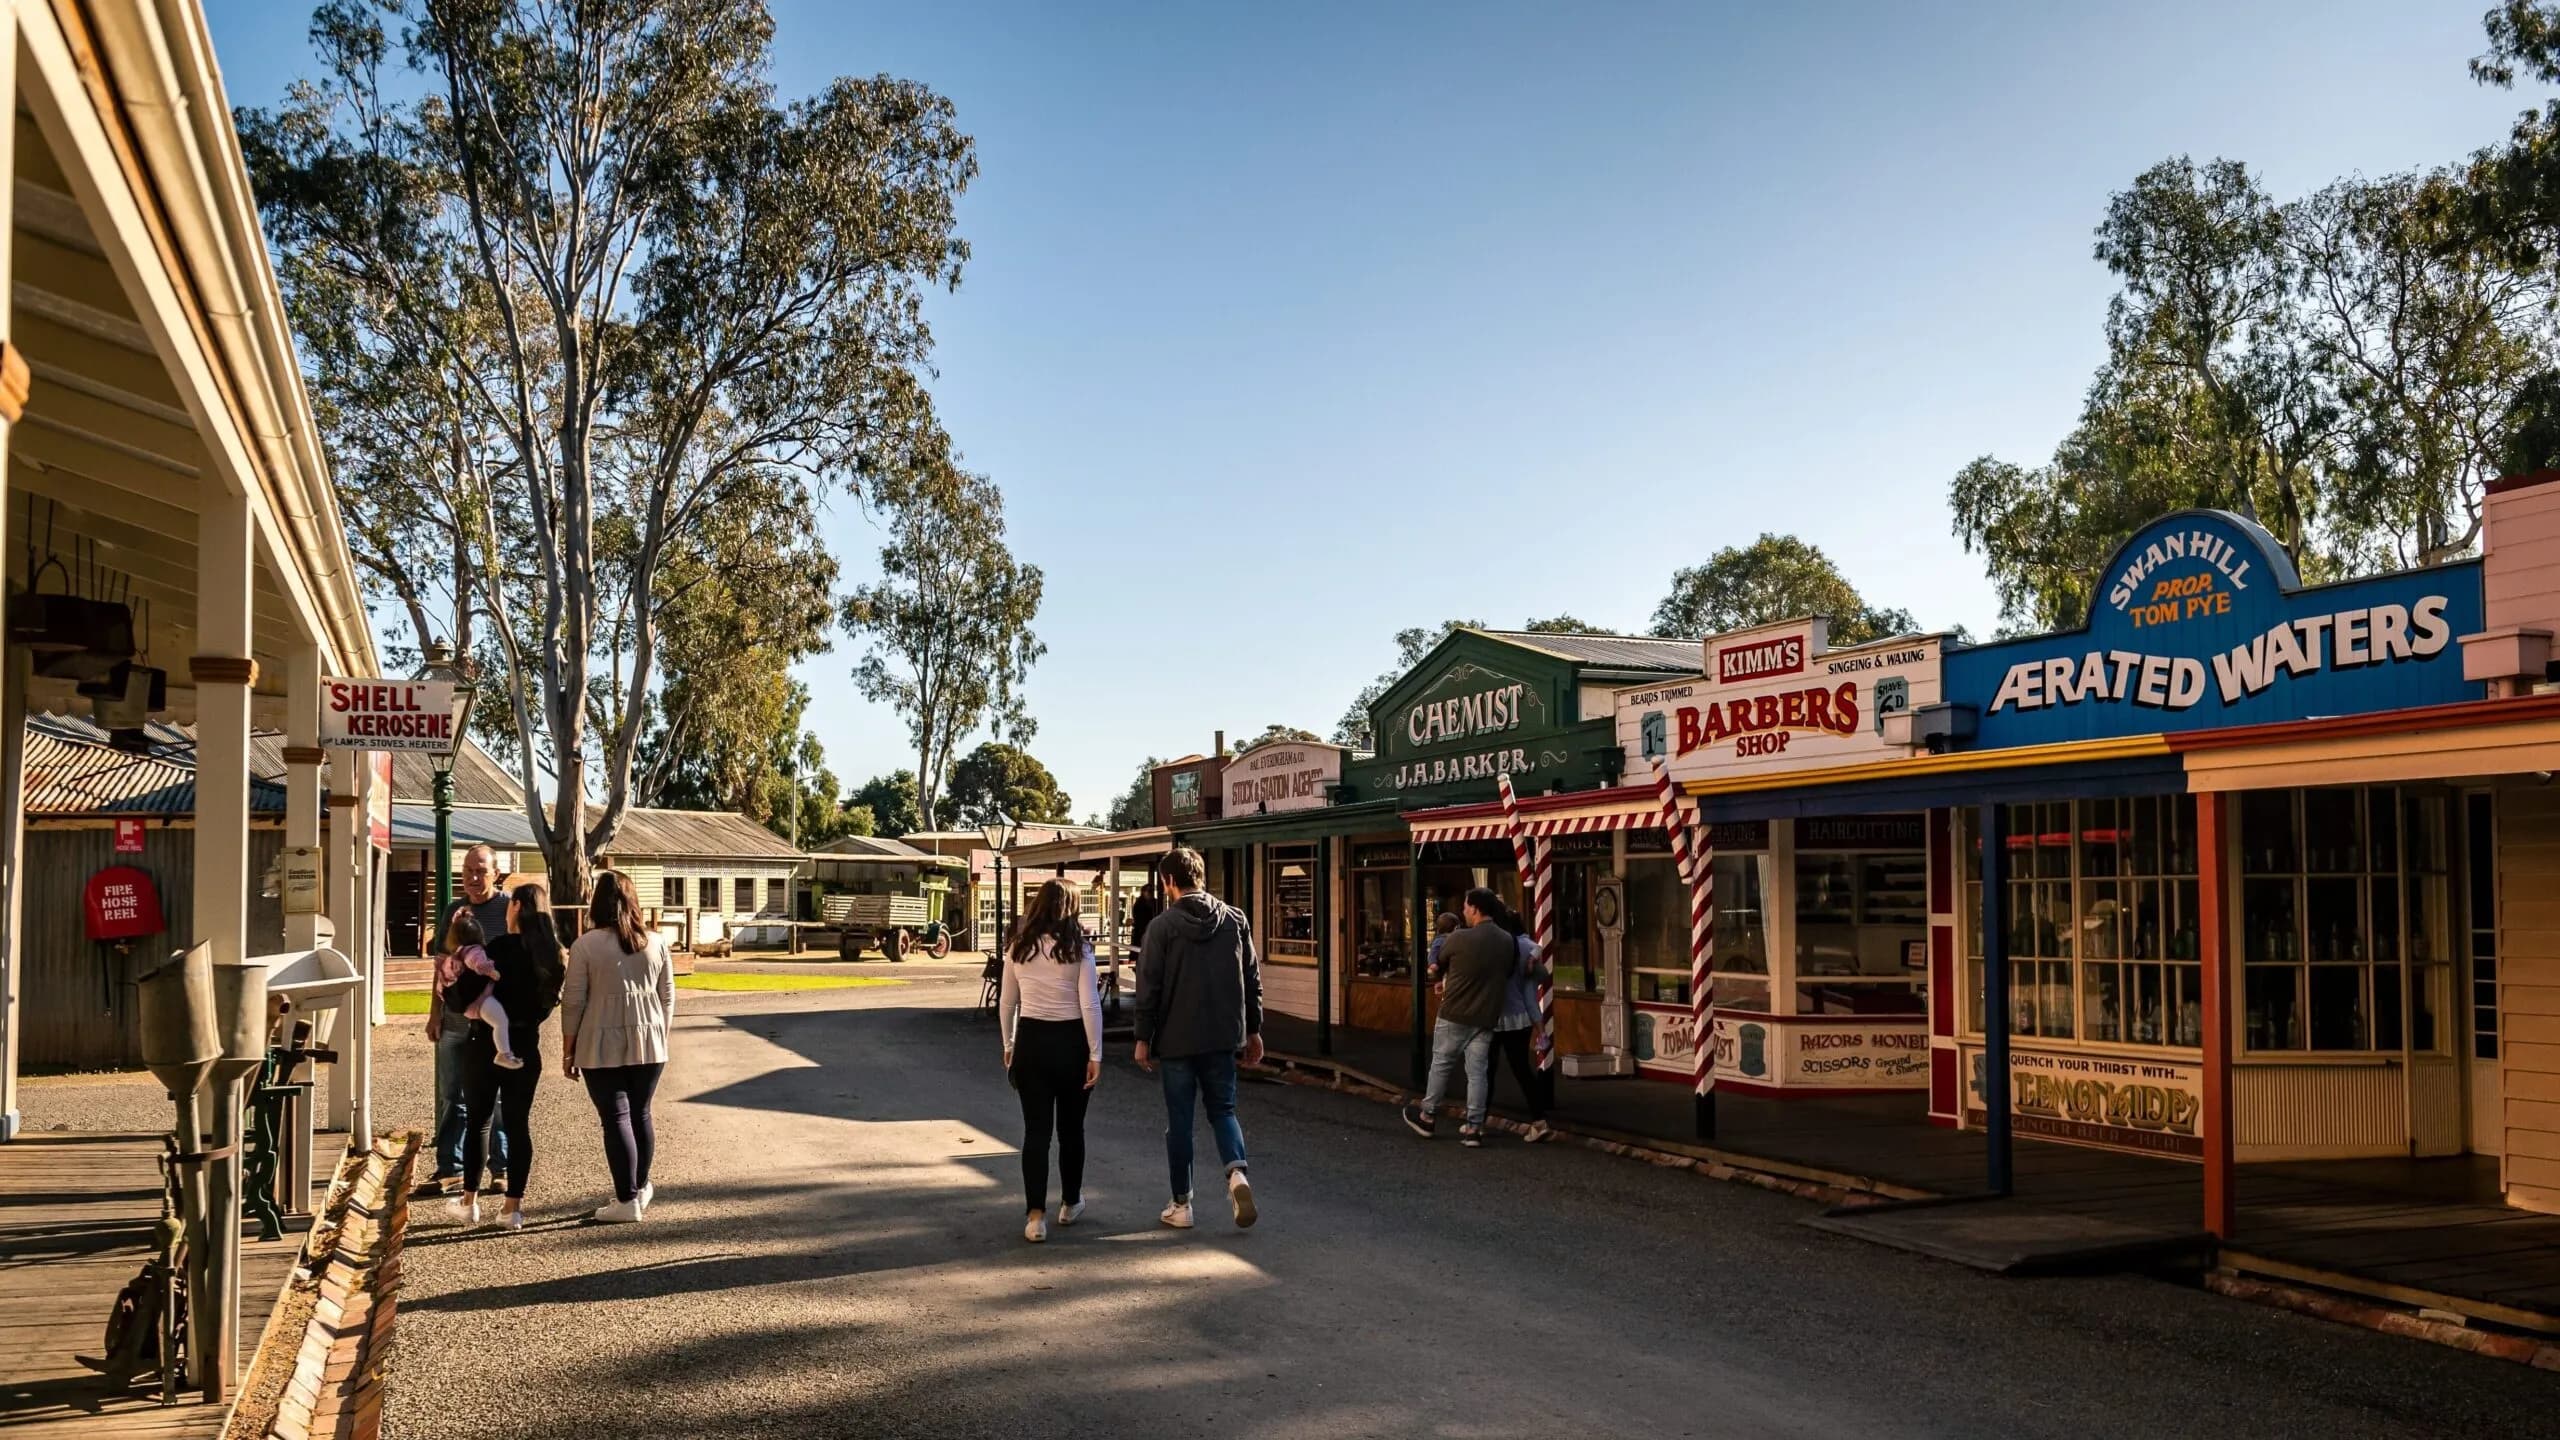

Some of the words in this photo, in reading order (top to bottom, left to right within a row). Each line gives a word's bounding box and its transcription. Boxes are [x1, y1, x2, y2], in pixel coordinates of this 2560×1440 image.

[2152, 573, 2213, 602] PROP.
[2129, 601, 2180, 629] TOM
[2187, 591, 2232, 619] PYE
[1723, 640, 1800, 678] KIMM'S
[1828, 657, 1872, 675] SINGEING
[1874, 654, 1883, 668] &
[1887, 649, 1925, 667] WAXING
[2211, 595, 2450, 704] WATERS
[1630, 691, 1659, 707] BEARDS
[1660, 686, 1693, 703] TRIMMED
[1877, 681, 1903, 699] SHAVE
[347, 714, 453, 739] KEROSENE
[1408, 684, 1523, 745] CHEMIST
[1676, 681, 1860, 759] BARBERS
[1736, 731, 1790, 758] SHOP
[1232, 780, 1255, 806] STOCK
[1260, 773, 1290, 801] STATION
[1808, 820, 1922, 841] HAIRCUTTING
[101, 896, 138, 909] HOSE
[104, 884, 133, 897] FIRE
[104, 908, 138, 921] REEL
[1800, 1034, 1863, 1052] RAZORS
[1801, 1056, 1871, 1073] SCISSORS
[1875, 1053, 1911, 1069] Ground
[2010, 1054, 2053, 1069] QUENCH
[2057, 1058, 2090, 1073] YOUR
[2093, 1062, 2137, 1076] THIRST
